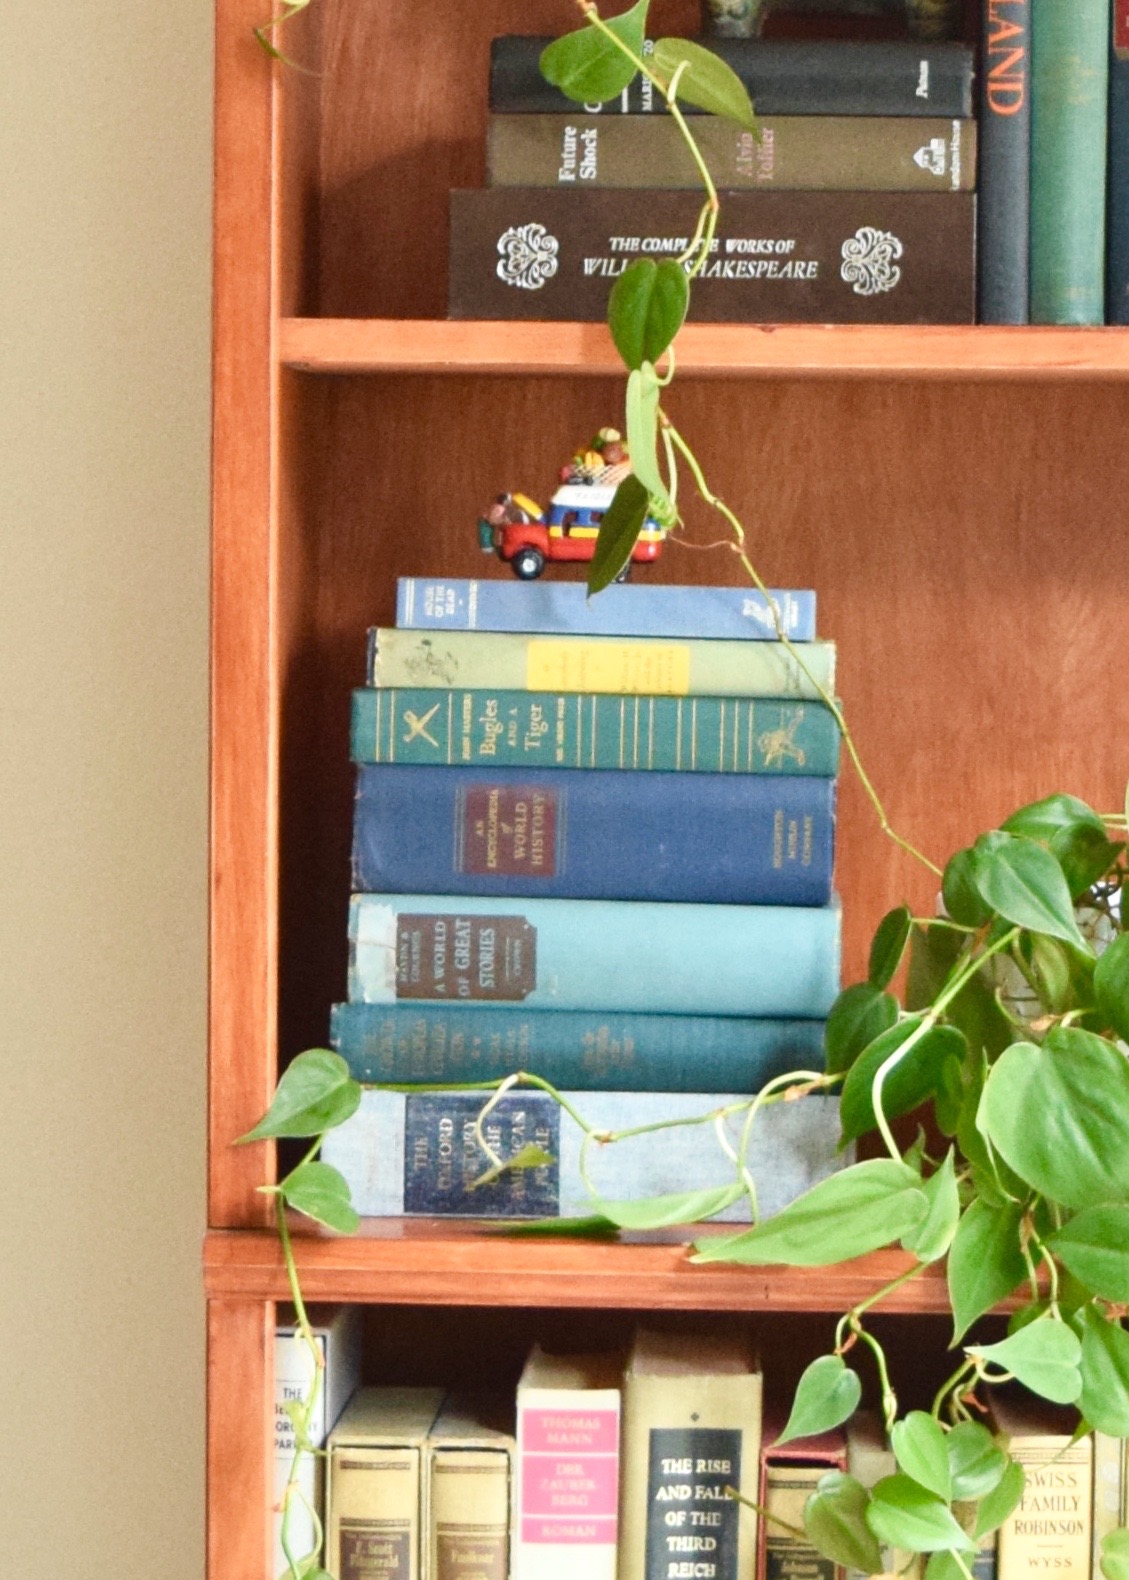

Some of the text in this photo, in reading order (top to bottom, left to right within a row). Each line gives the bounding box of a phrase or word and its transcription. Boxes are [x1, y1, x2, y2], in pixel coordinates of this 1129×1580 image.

[557, 125, 578, 184] Future
[579, 126, 598, 181] Shock
[609, 236, 796, 254] THE WORKS OF
[479, 698, 504, 756] Bugles
[507, 705, 518, 747] AND A
[524, 703, 549, 752] Tiger
[513, 801, 528, 859] WORLD
[530, 792, 545, 866] HISTORY
[433, 920, 447, 993] A WORLD
[454, 918, 471, 996] OF GREAT
[478, 927, 496, 989] STORIES
[413, 1136, 428, 1168] THE
[283, 1387, 302, 1399] THE
[541, 1416, 602, 1431] THOMAS
[546, 1432, 593, 1446] MANN
[555, 1463, 586, 1477] DER
[661, 1457, 732, 1474] THE RISE
[539, 1477, 598, 1492] ZAUBER
[1023, 1471, 1078, 1489] SWISS
[551, 1493, 589, 1507] BERG
[655, 1485, 734, 1501] AND FALL
[1020, 1495, 1082, 1512] FAMILY
[664, 1511, 722, 1527] OF THE
[1014, 1519, 1085, 1536] ROBINSON
[541, 1524, 598, 1538] ROMAN
[666, 1535, 718, 1552] THIRD
[668, 1562, 717, 1579] REICH
[1027, 1557, 1073, 1569] WYSS
